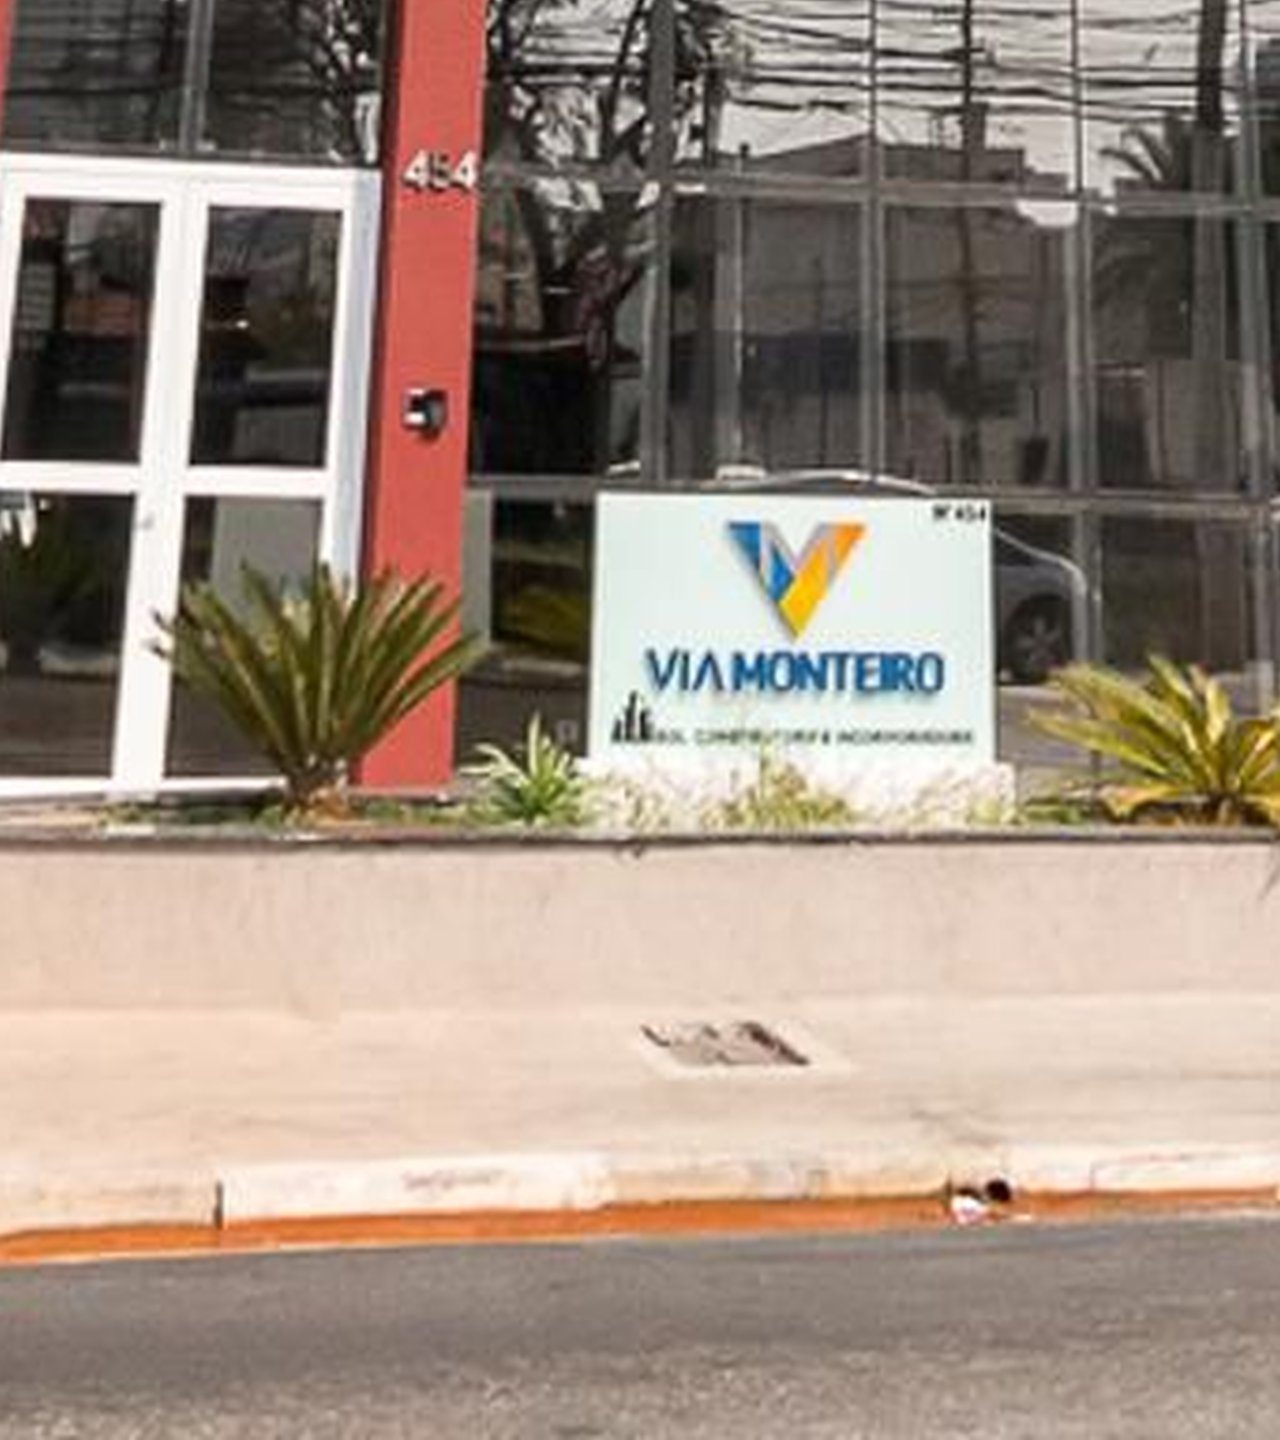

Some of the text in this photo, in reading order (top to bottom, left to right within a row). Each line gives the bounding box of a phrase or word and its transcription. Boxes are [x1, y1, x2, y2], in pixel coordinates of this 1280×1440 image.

[402, 147, 478, 189] 454
[645, 647, 946, 693] VIA MONTEIRO
